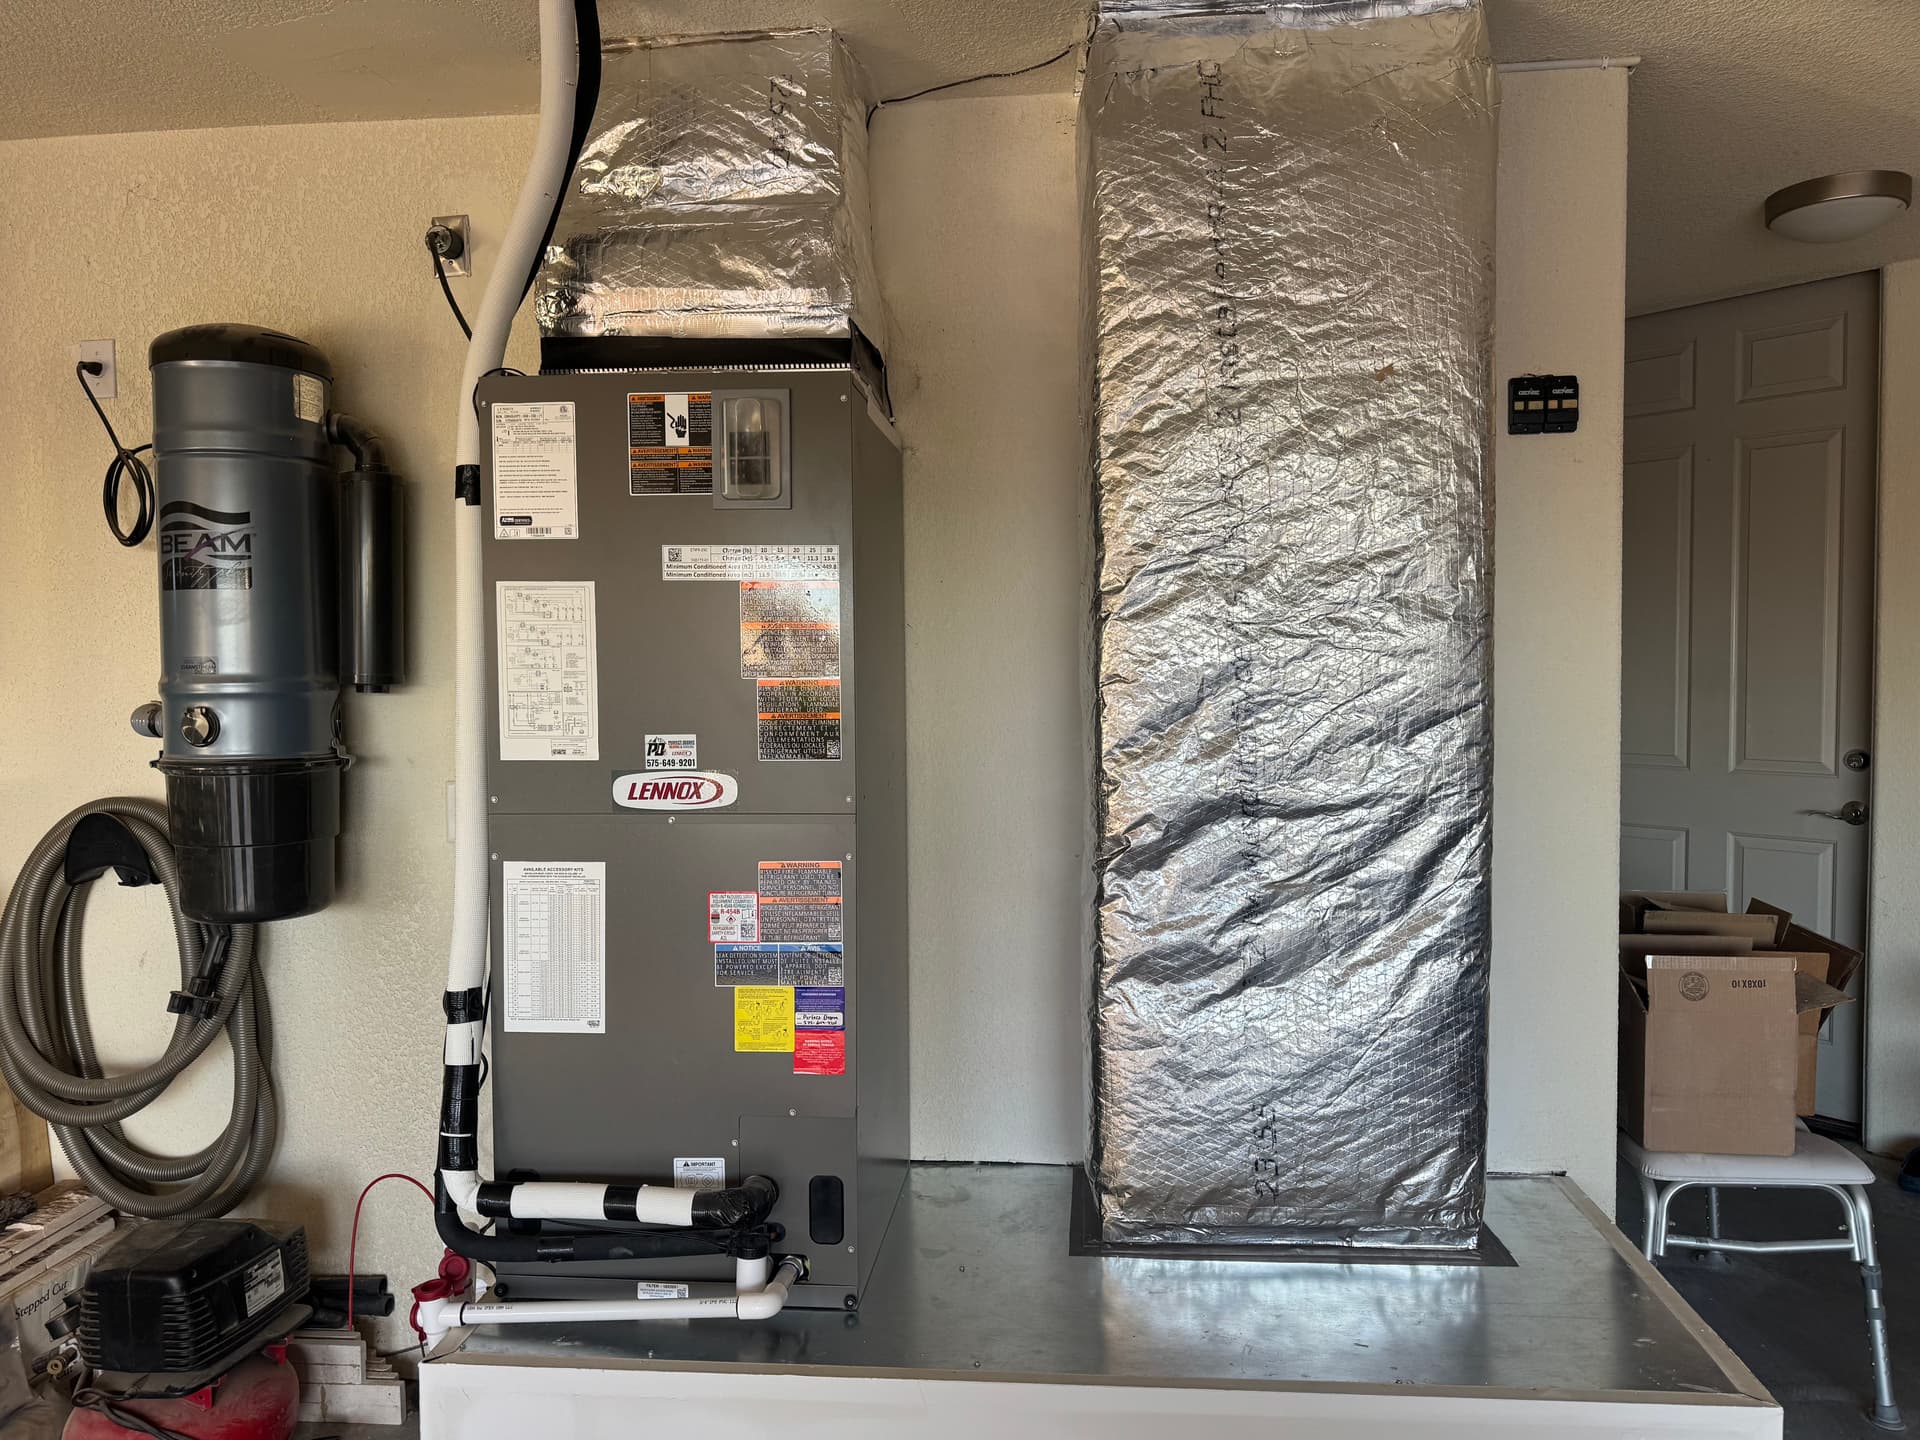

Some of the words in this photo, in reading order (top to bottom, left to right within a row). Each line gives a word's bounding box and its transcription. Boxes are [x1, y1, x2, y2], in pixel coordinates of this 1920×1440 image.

[161, 533, 252, 555] BEAM
[647, 759, 696, 767] 575-649-9201
[627, 782, 704, 800] LENNOX
[15, 1289, 50, 1320] Stepped
